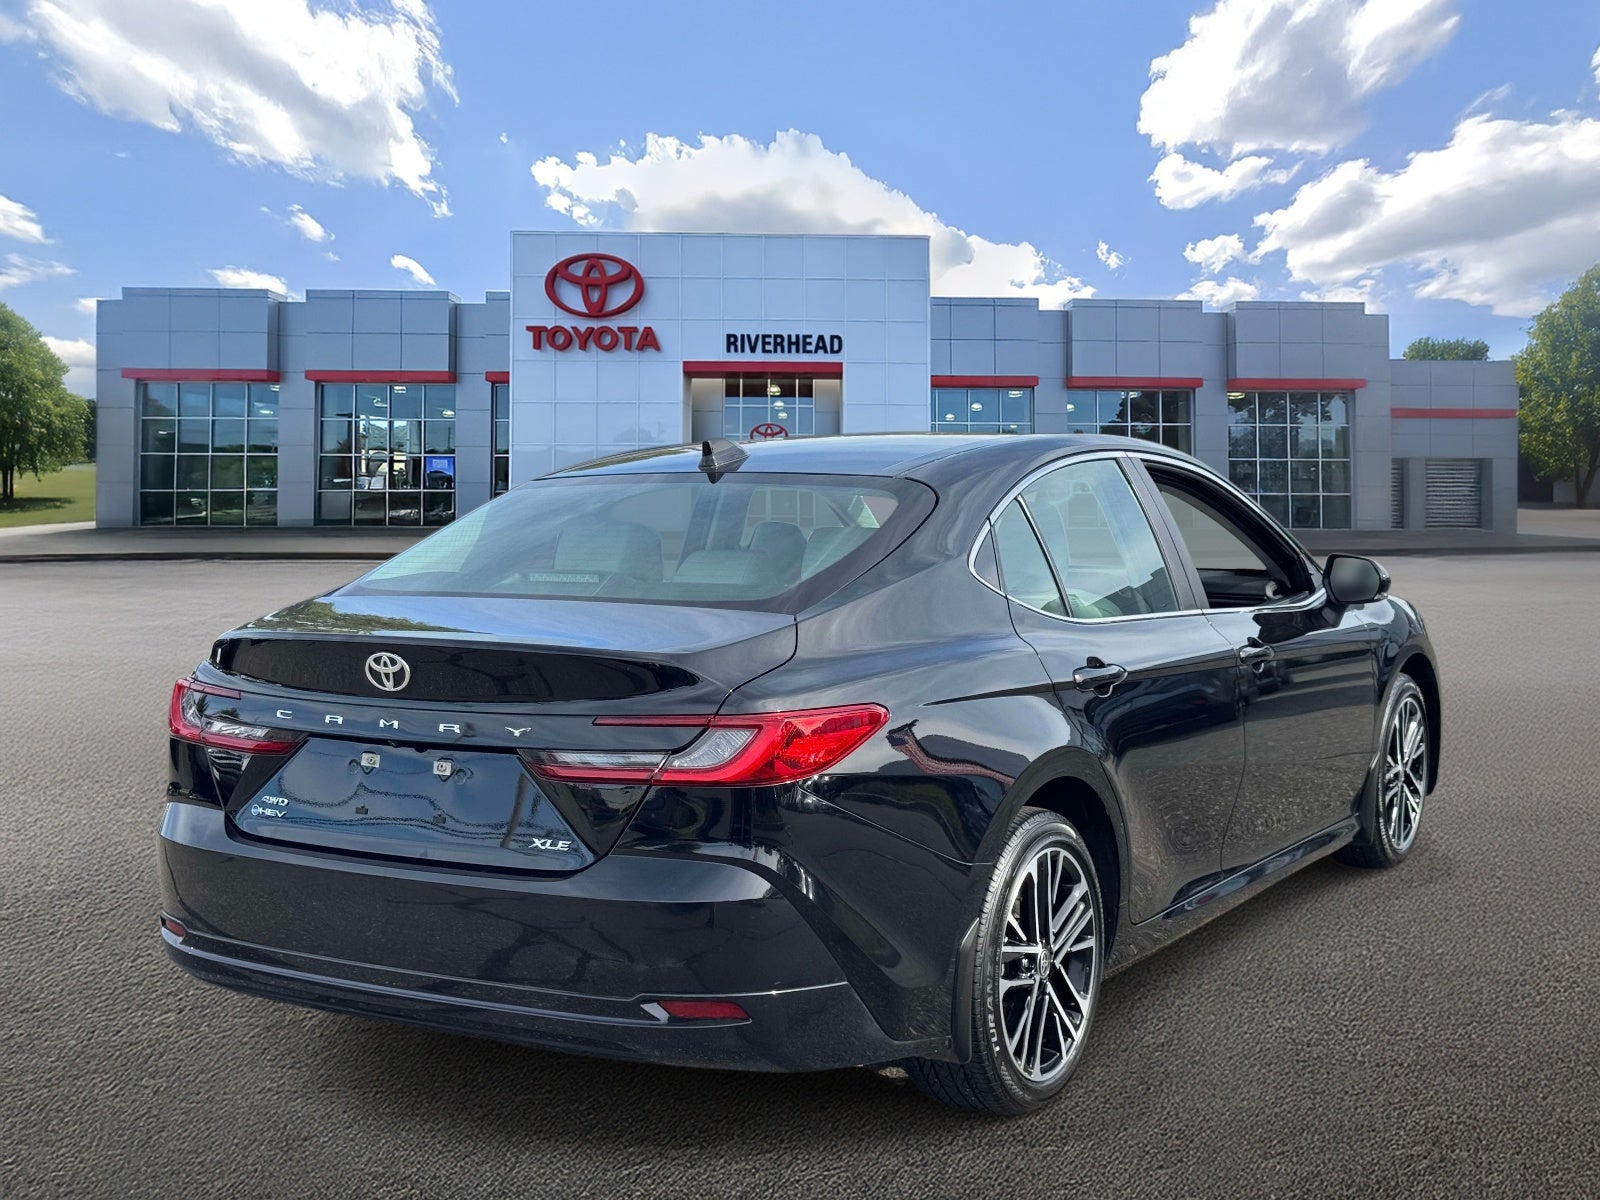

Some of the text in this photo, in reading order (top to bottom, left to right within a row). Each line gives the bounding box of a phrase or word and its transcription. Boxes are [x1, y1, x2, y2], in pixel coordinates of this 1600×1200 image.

[525, 325, 661, 352] TOYOTA
[725, 333, 843, 354] RIVERHEAD
[276, 709, 532, 737] CAMRY
[261, 795, 289, 807] AWD
[528, 837, 572, 851] XLE
